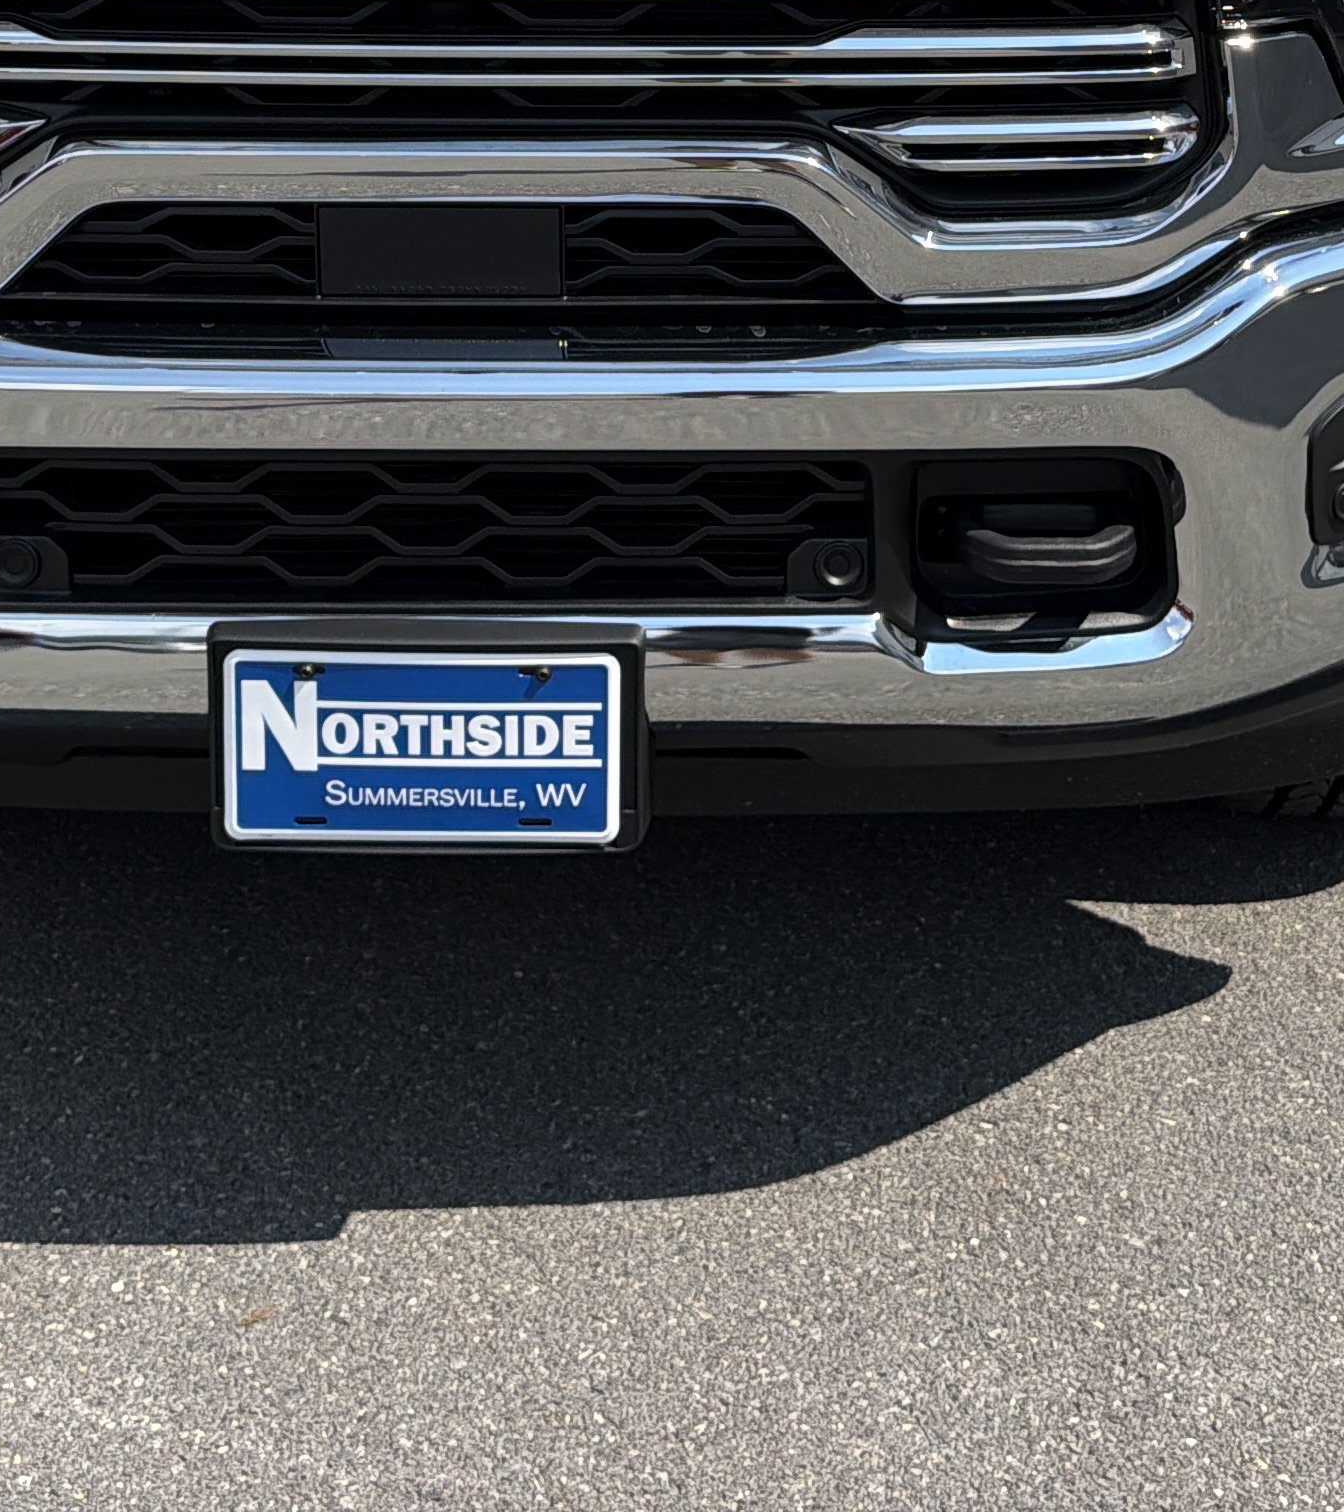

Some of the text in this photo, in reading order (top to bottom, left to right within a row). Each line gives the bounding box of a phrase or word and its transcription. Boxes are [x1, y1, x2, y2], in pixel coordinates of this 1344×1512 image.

[240, 679, 595, 772] NORTHSIDE
[324, 779, 588, 811] SUMMERSVILLE, WV
